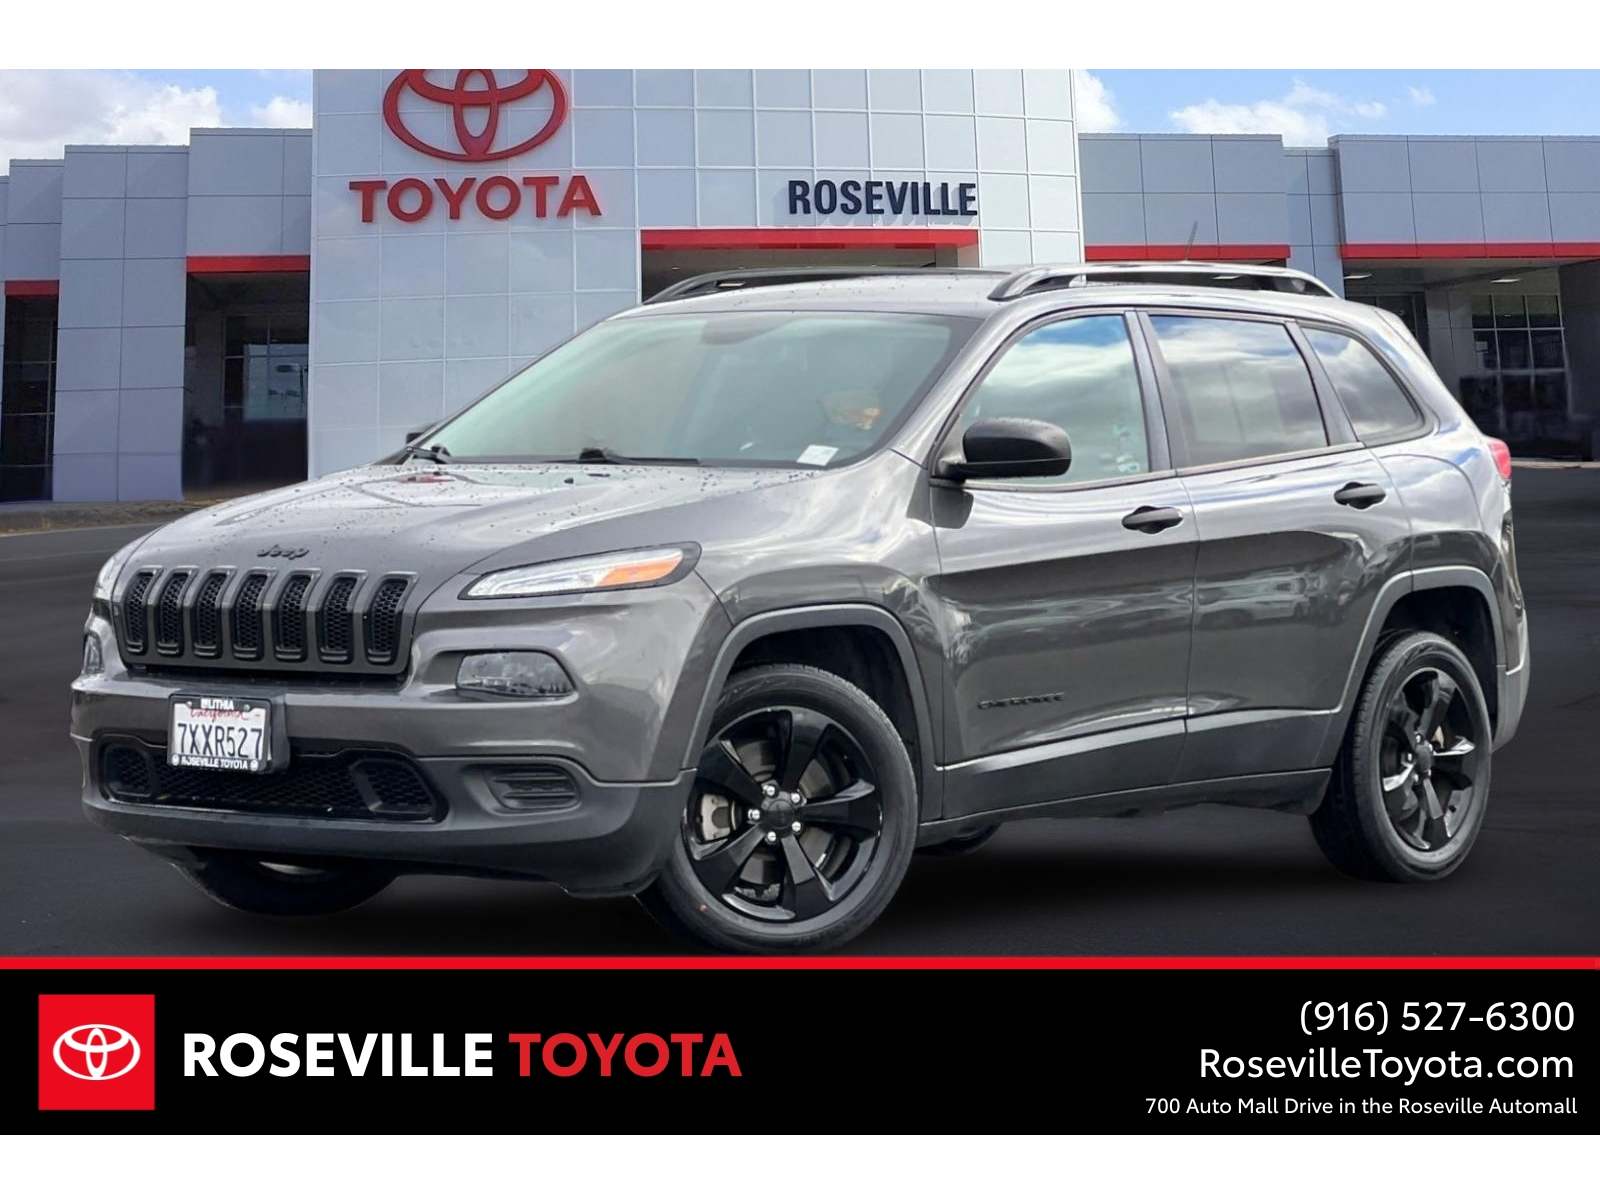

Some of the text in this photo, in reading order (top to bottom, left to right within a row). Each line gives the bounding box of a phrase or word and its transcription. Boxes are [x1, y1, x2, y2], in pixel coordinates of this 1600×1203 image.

[349, 175, 602, 223] TOYOTA
[788, 180, 978, 217] ROSEVILLE
[177, 723, 262, 759] 7XXR527
